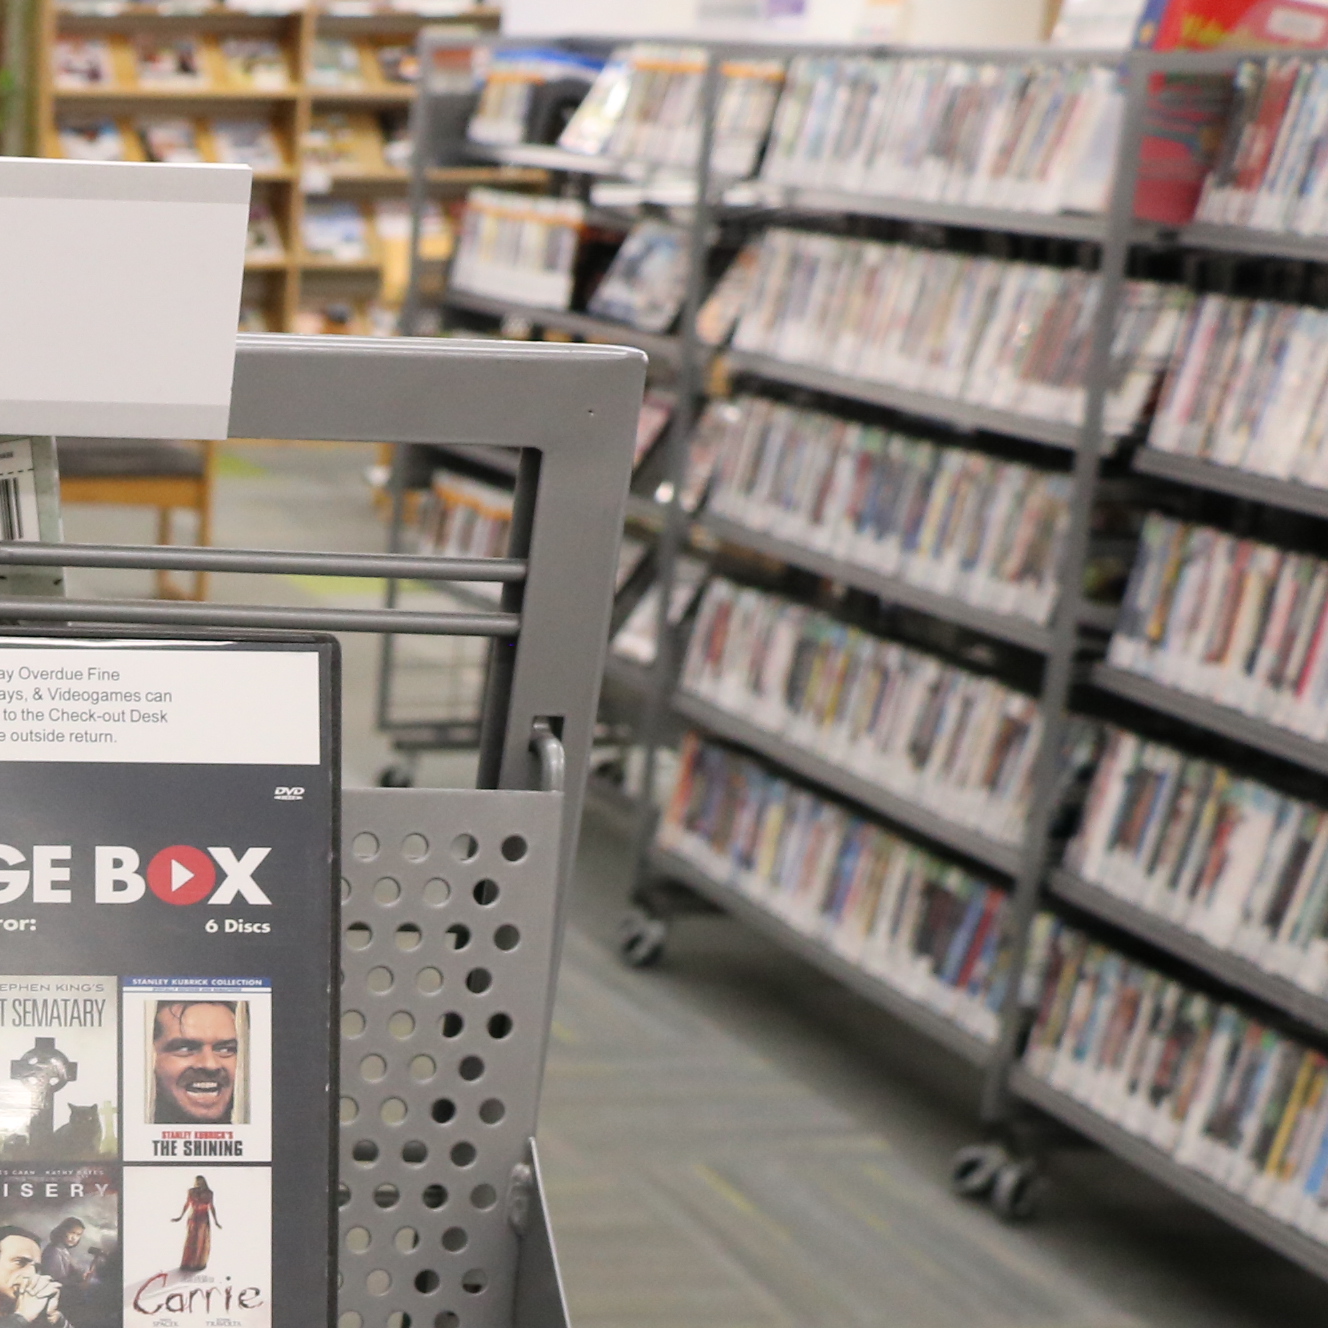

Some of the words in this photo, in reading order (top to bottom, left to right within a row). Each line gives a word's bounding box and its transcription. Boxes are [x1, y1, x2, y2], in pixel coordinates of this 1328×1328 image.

[18, 666, 83, 680] Overdue
[87, 667, 120, 681] Fine
[32, 688, 43, 702] &
[47, 688, 141, 705] Videogames
[145, 691, 172, 703] can
[1, 709, 14, 722] to
[18, 707, 44, 722] the
[48, 707, 125, 723] Check-out
[130, 708, 168, 723] Desk
[10, 728, 66, 743] outside
[70, 730, 117, 743] return.
[95, 844, 272, 905] BOX
[205, 920, 217, 933] 6
[224, 919, 270, 934] Discs
[13, 999, 105, 1027] SEMATARY
[152, 1140, 176, 1156] THE
[183, 1140, 242, 1156] SHINING
[134, 1273, 263, 1314] Carrie
